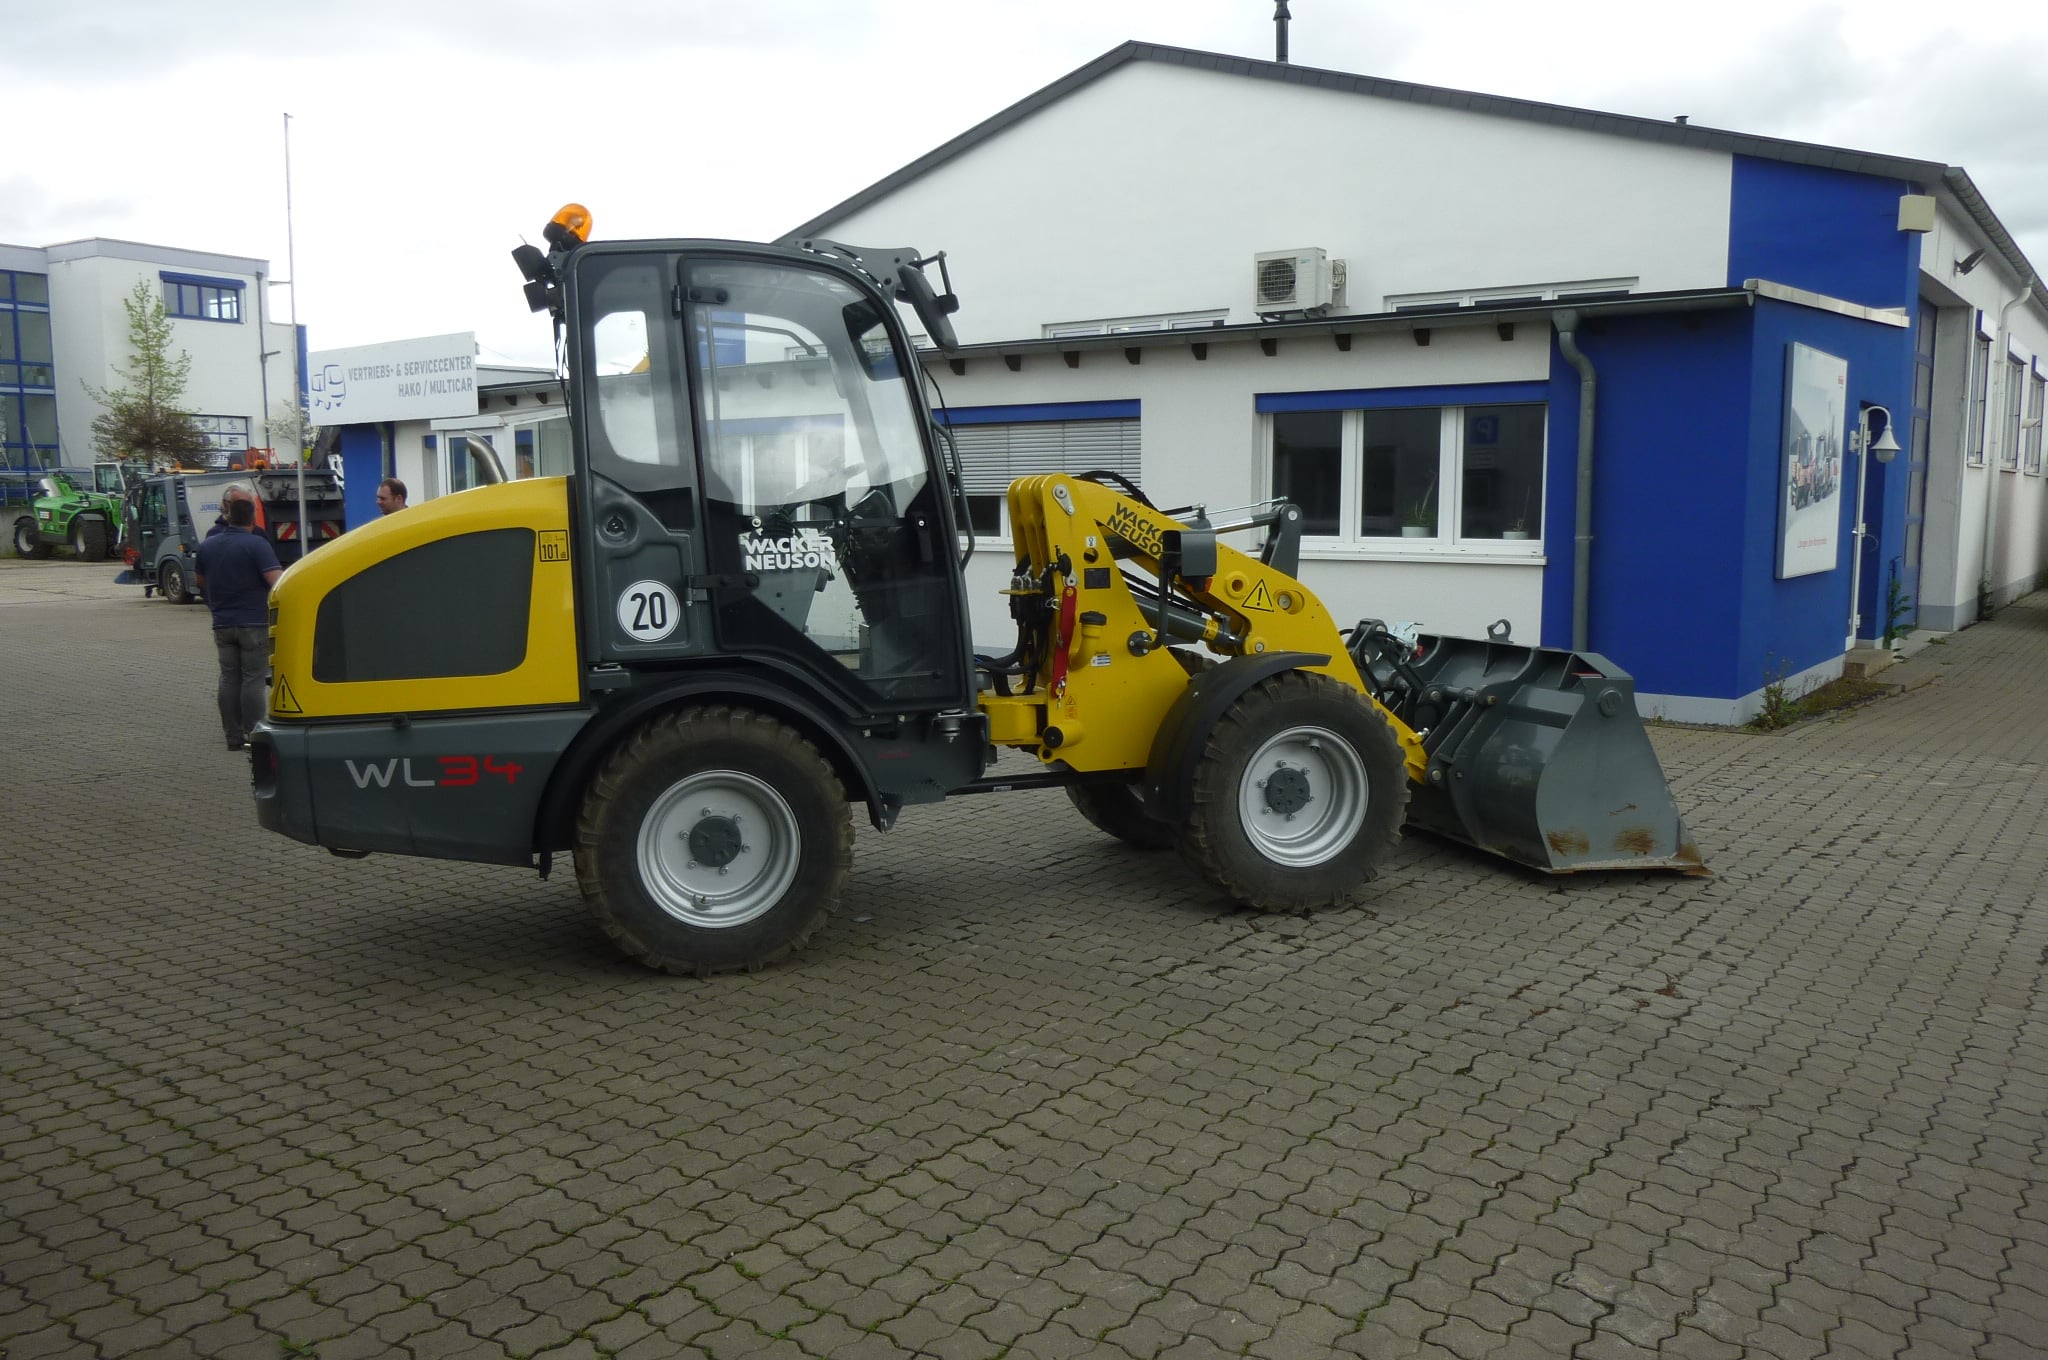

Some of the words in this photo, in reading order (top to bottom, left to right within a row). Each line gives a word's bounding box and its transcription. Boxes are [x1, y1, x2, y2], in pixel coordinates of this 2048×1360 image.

[348, 366, 394, 382] VERTRIEBS-
[404, 355, 473, 376] SERVICECENTER
[398, 382, 421, 398] HAKO
[430, 377, 473, 395] MULTICAR
[1106, 514, 1162, 556] NEUSO
[1115, 502, 1163, 545] WACK
[542, 543, 559, 559] 101
[744, 536, 835, 554] WACKER
[745, 551, 836, 570] NEUSON
[630, 591, 668, 631] 20
[345, 755, 524, 789] WL34
